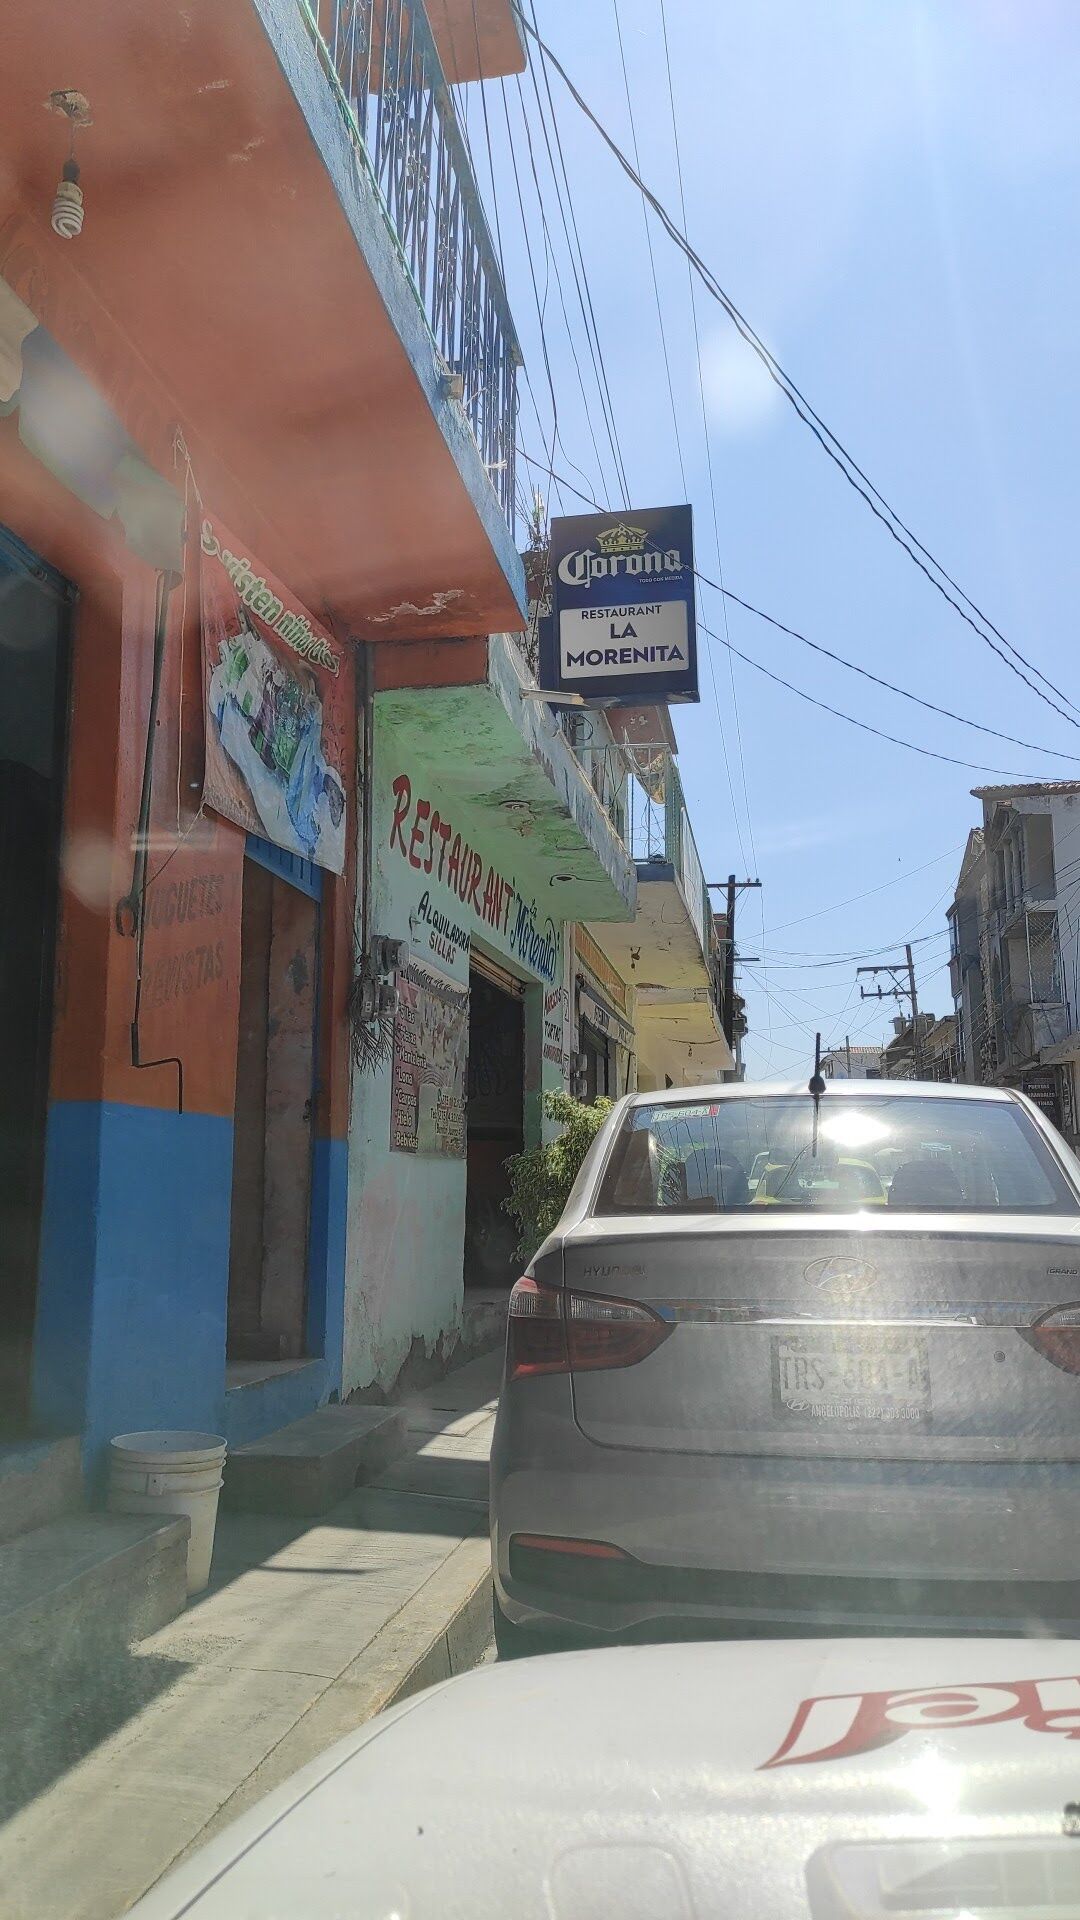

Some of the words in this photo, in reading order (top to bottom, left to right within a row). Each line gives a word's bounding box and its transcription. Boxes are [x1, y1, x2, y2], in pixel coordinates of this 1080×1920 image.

[558, 549, 684, 588] Corona
[581, 605, 662, 620] RESTAURANT
[610, 622, 637, 639] LA
[566, 644, 684, 667] MORENITA
[390, 774, 514, 936] RESTAURANT
[417, 890, 471, 954] ALQUILADORA
[429, 930, 457, 965] SILLAS
[396, 1131, 418, 1149] Bebidas
